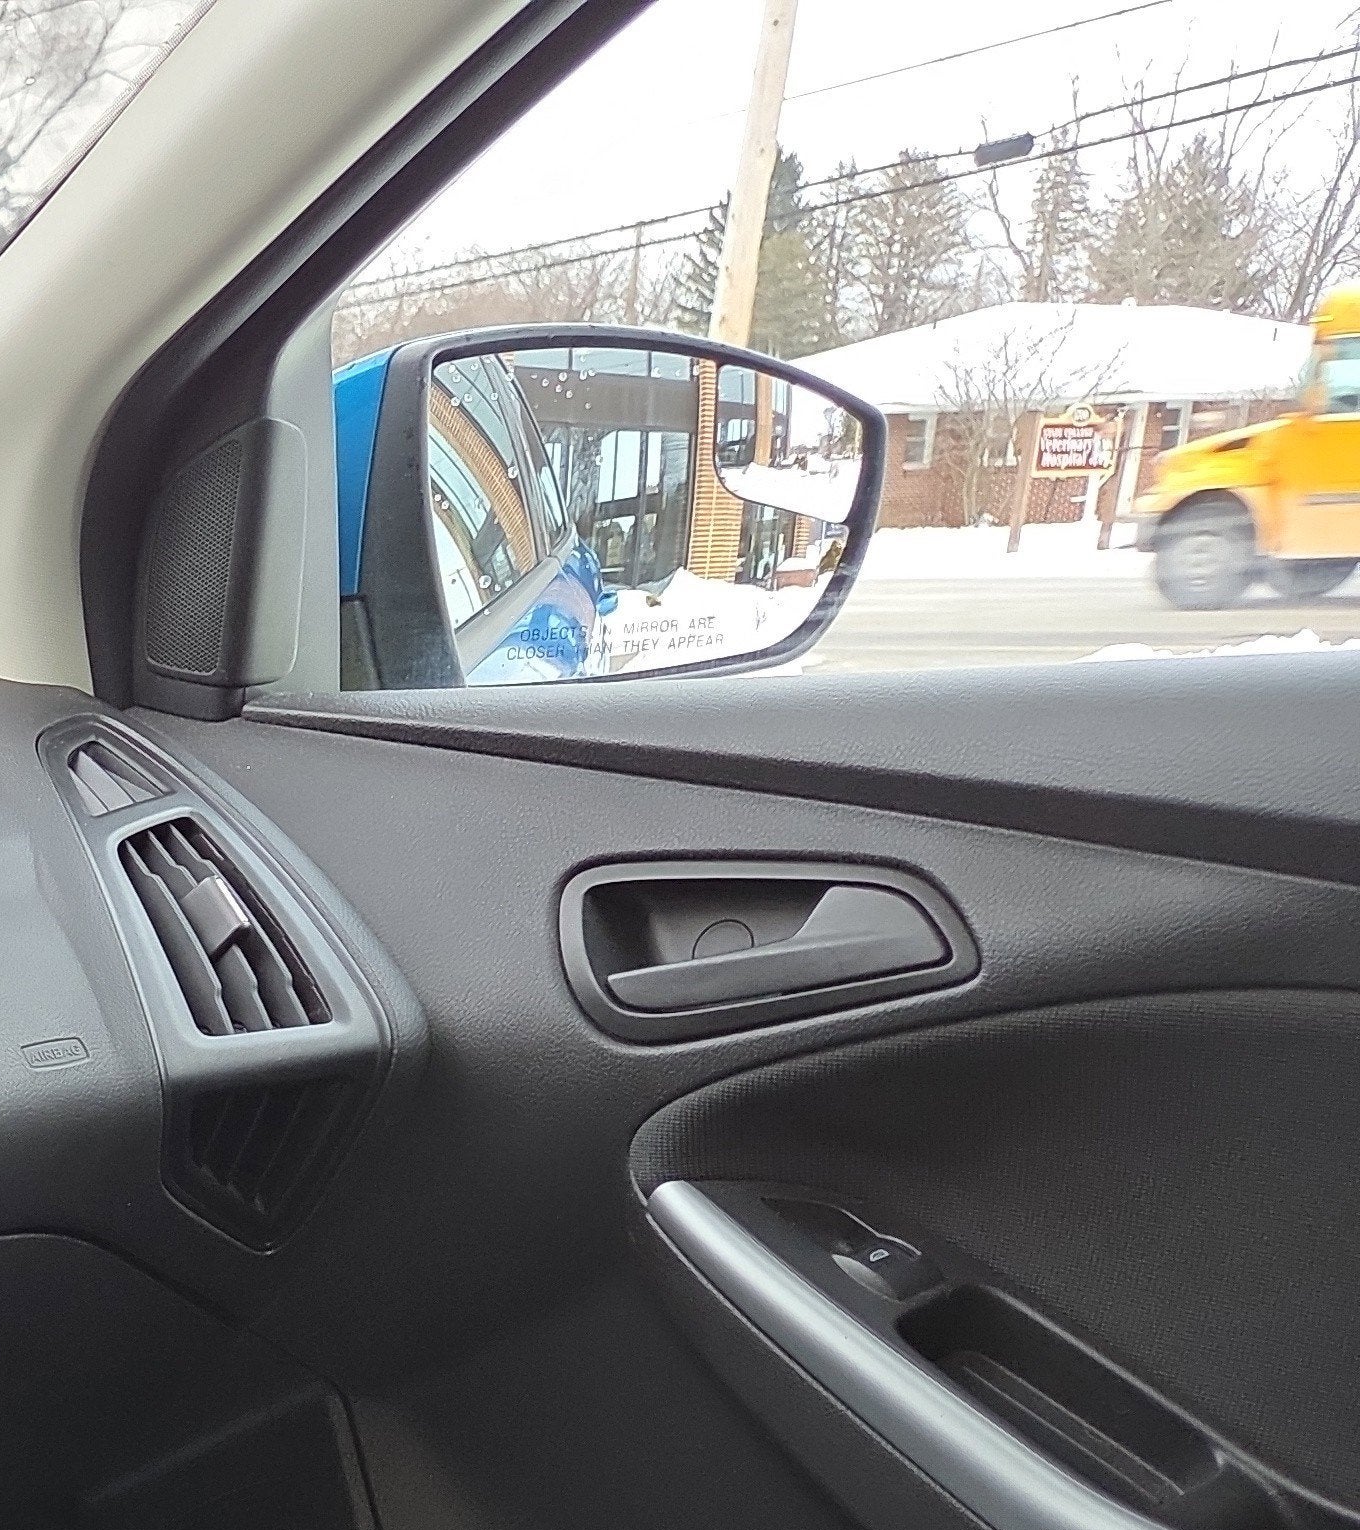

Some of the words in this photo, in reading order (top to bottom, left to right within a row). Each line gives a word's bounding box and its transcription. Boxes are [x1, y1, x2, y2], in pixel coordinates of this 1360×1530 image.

[520, 625, 588, 643] OBJECTS
[623, 619, 679, 636] MIRROR
[687, 616, 716, 630] ARE
[506, 645, 566, 661] CLOSER
[575, 640, 613, 655] THAN
[622, 638, 660, 653] THEY
[667, 633, 725, 650] APPEAR
